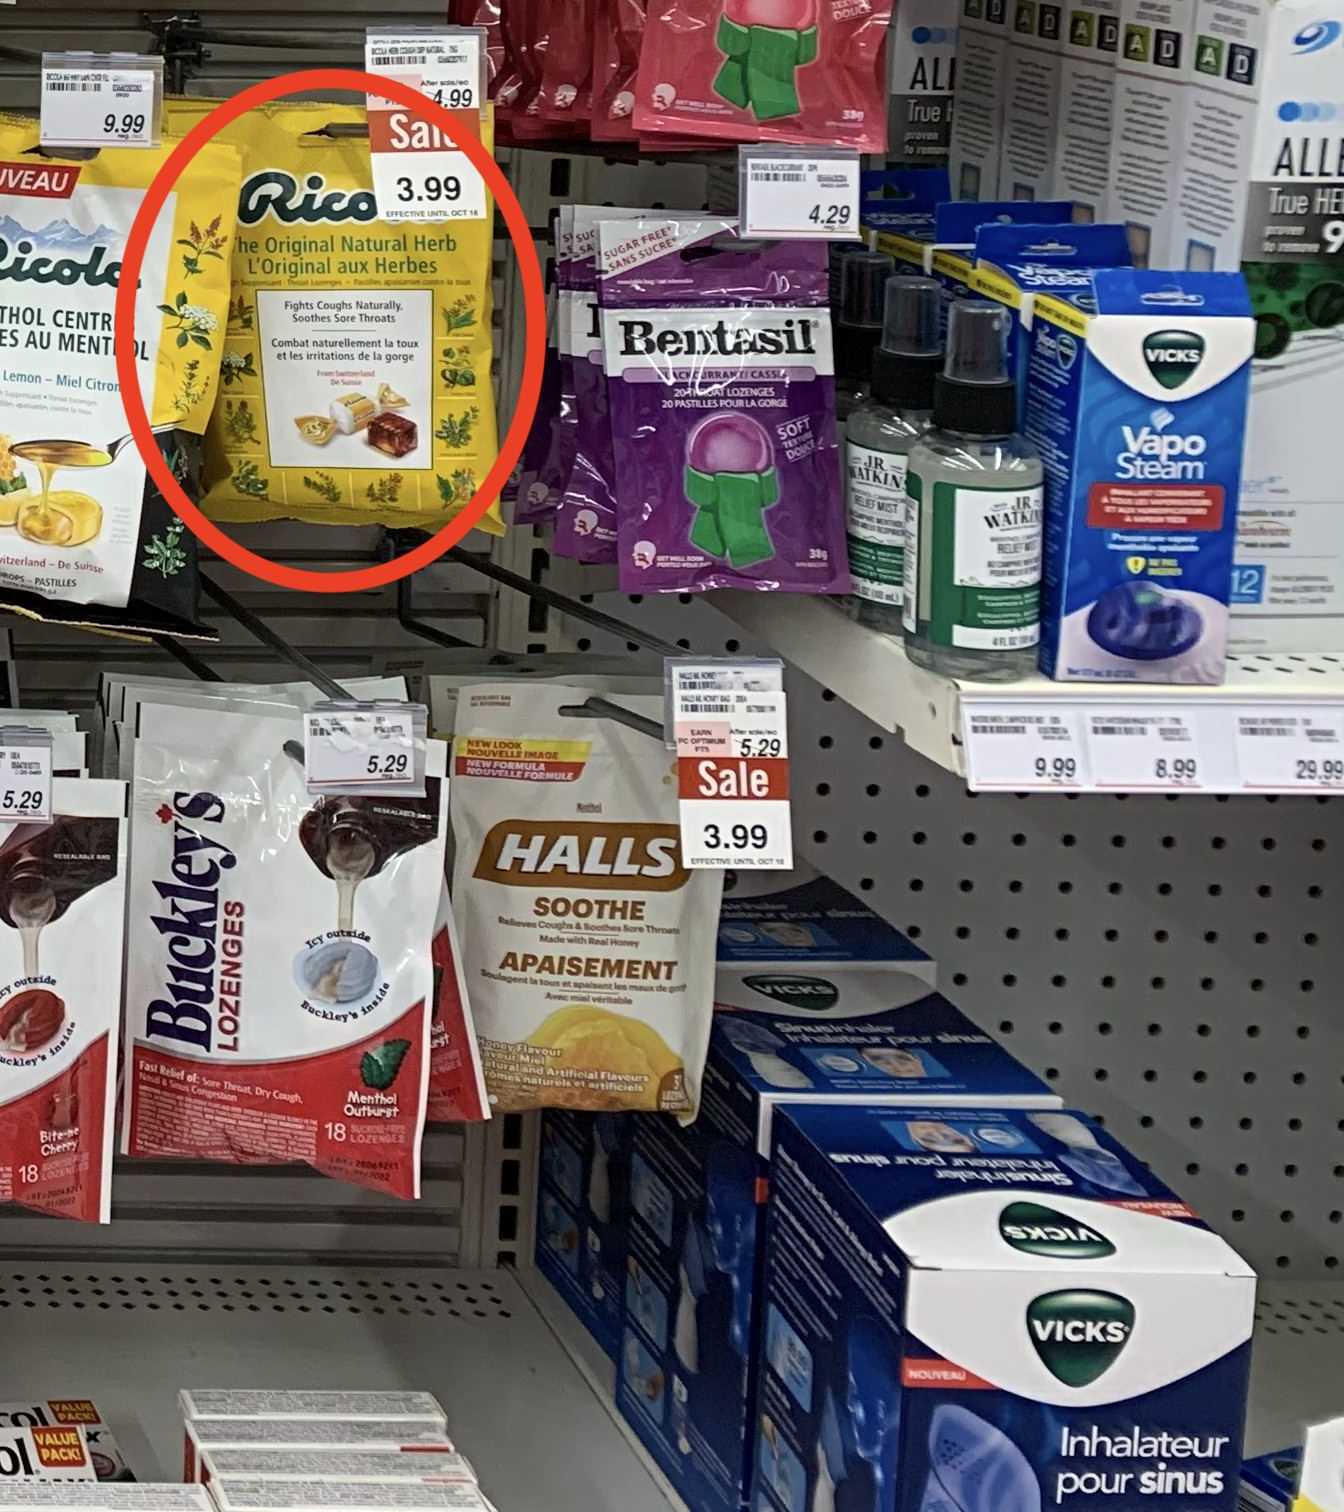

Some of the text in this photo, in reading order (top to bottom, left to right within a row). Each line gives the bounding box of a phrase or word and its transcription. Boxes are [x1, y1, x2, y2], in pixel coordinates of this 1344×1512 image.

[104, 114, 145, 134] 9.99
[397, 175, 460, 201] 3.99
[265, 234, 457, 256] Original Natural Herb
[249, 256, 437, 277] L'Original aux Herbes
[272, 338, 419, 349] Combat naturellement la toux
[1145, 349, 1200, 365] VICKS
[1121, 426, 1207, 466] Vapo
[1116, 453, 1205, 480] Steam
[1035, 758, 1076, 779] 9.99
[2, 790, 43, 811] 5.29
[496, 835, 676, 877] HALLS
[533, 897, 646, 920] SOOTHE
[1033, 1319, 1127, 1345] VICKS
[909, 1368, 966, 1381] NOUVEAU
[33, 1430, 80, 1447] VALUE
[1060, 1426, 1228, 1459] Inhalateur
[1057, 1466, 1224, 1501] pour sinus
